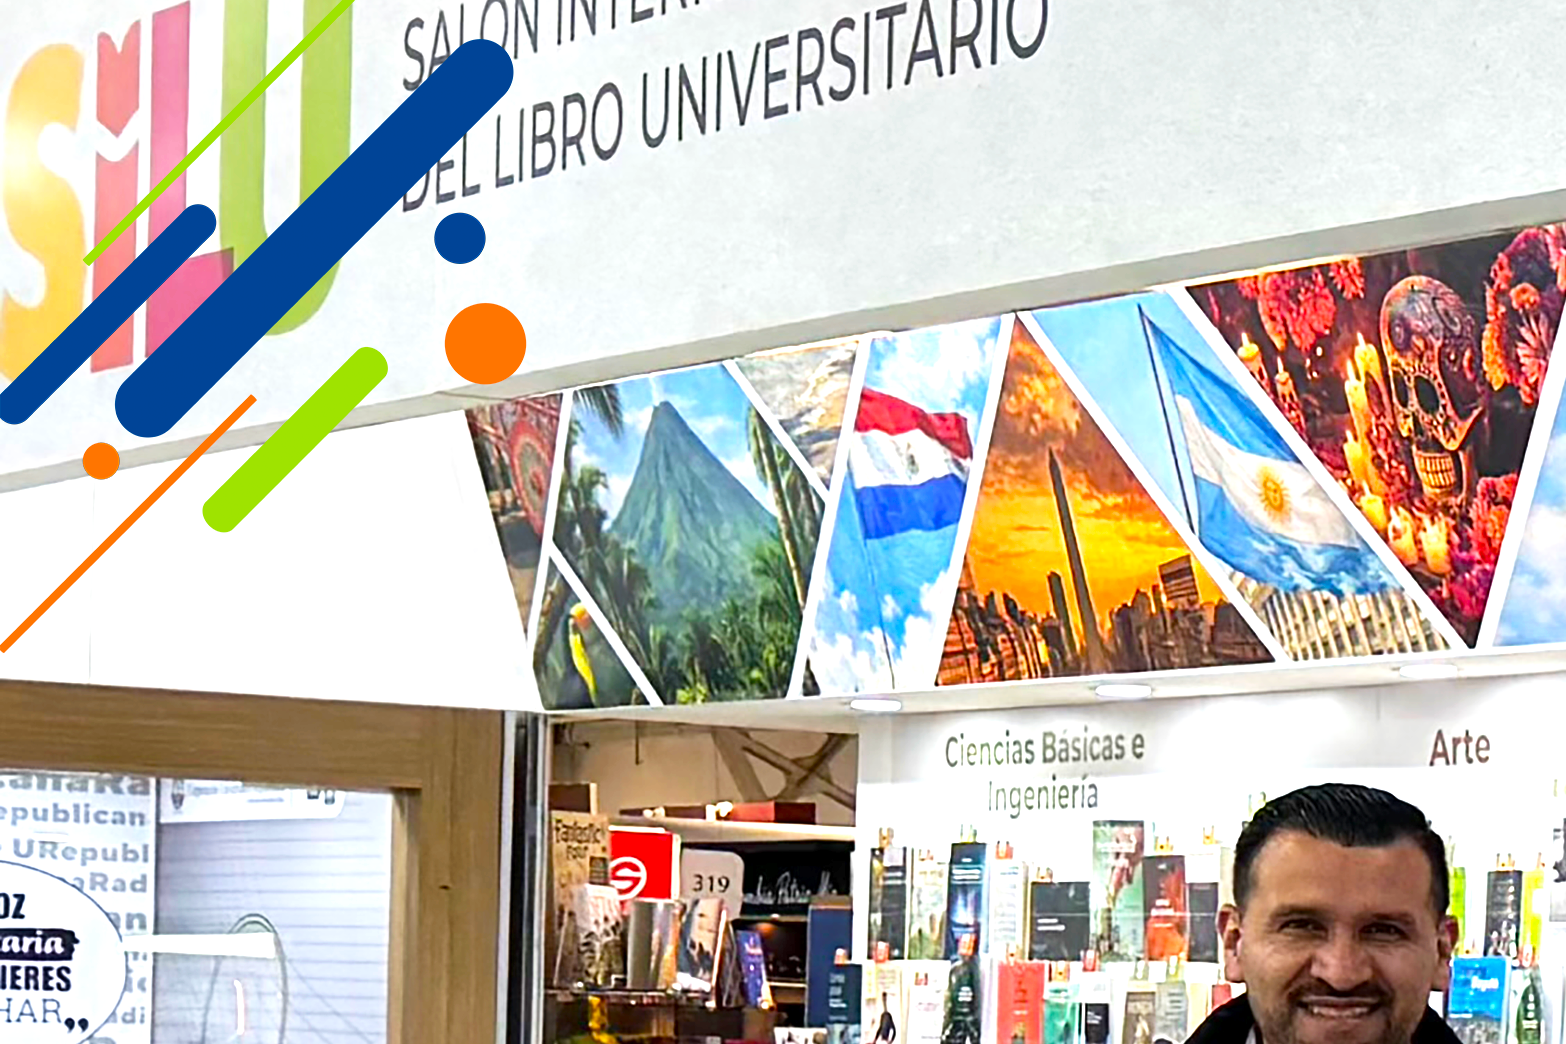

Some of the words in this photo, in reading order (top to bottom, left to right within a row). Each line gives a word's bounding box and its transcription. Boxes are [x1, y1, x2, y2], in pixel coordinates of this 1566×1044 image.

[495, 82, 623, 188] LIBRO
[642, 0, 1048, 148] UNIVERSITARIO
[945, 730, 1035, 767] Ciencias
[1041, 725, 1124, 764] Básicas
[1131, 733, 1145, 760] e
[1429, 729, 1491, 766] Arte
[988, 774, 1099, 819] Ingeniería
[13, 838, 149, 867] URepubl
[692, 873, 730, 893] 319
